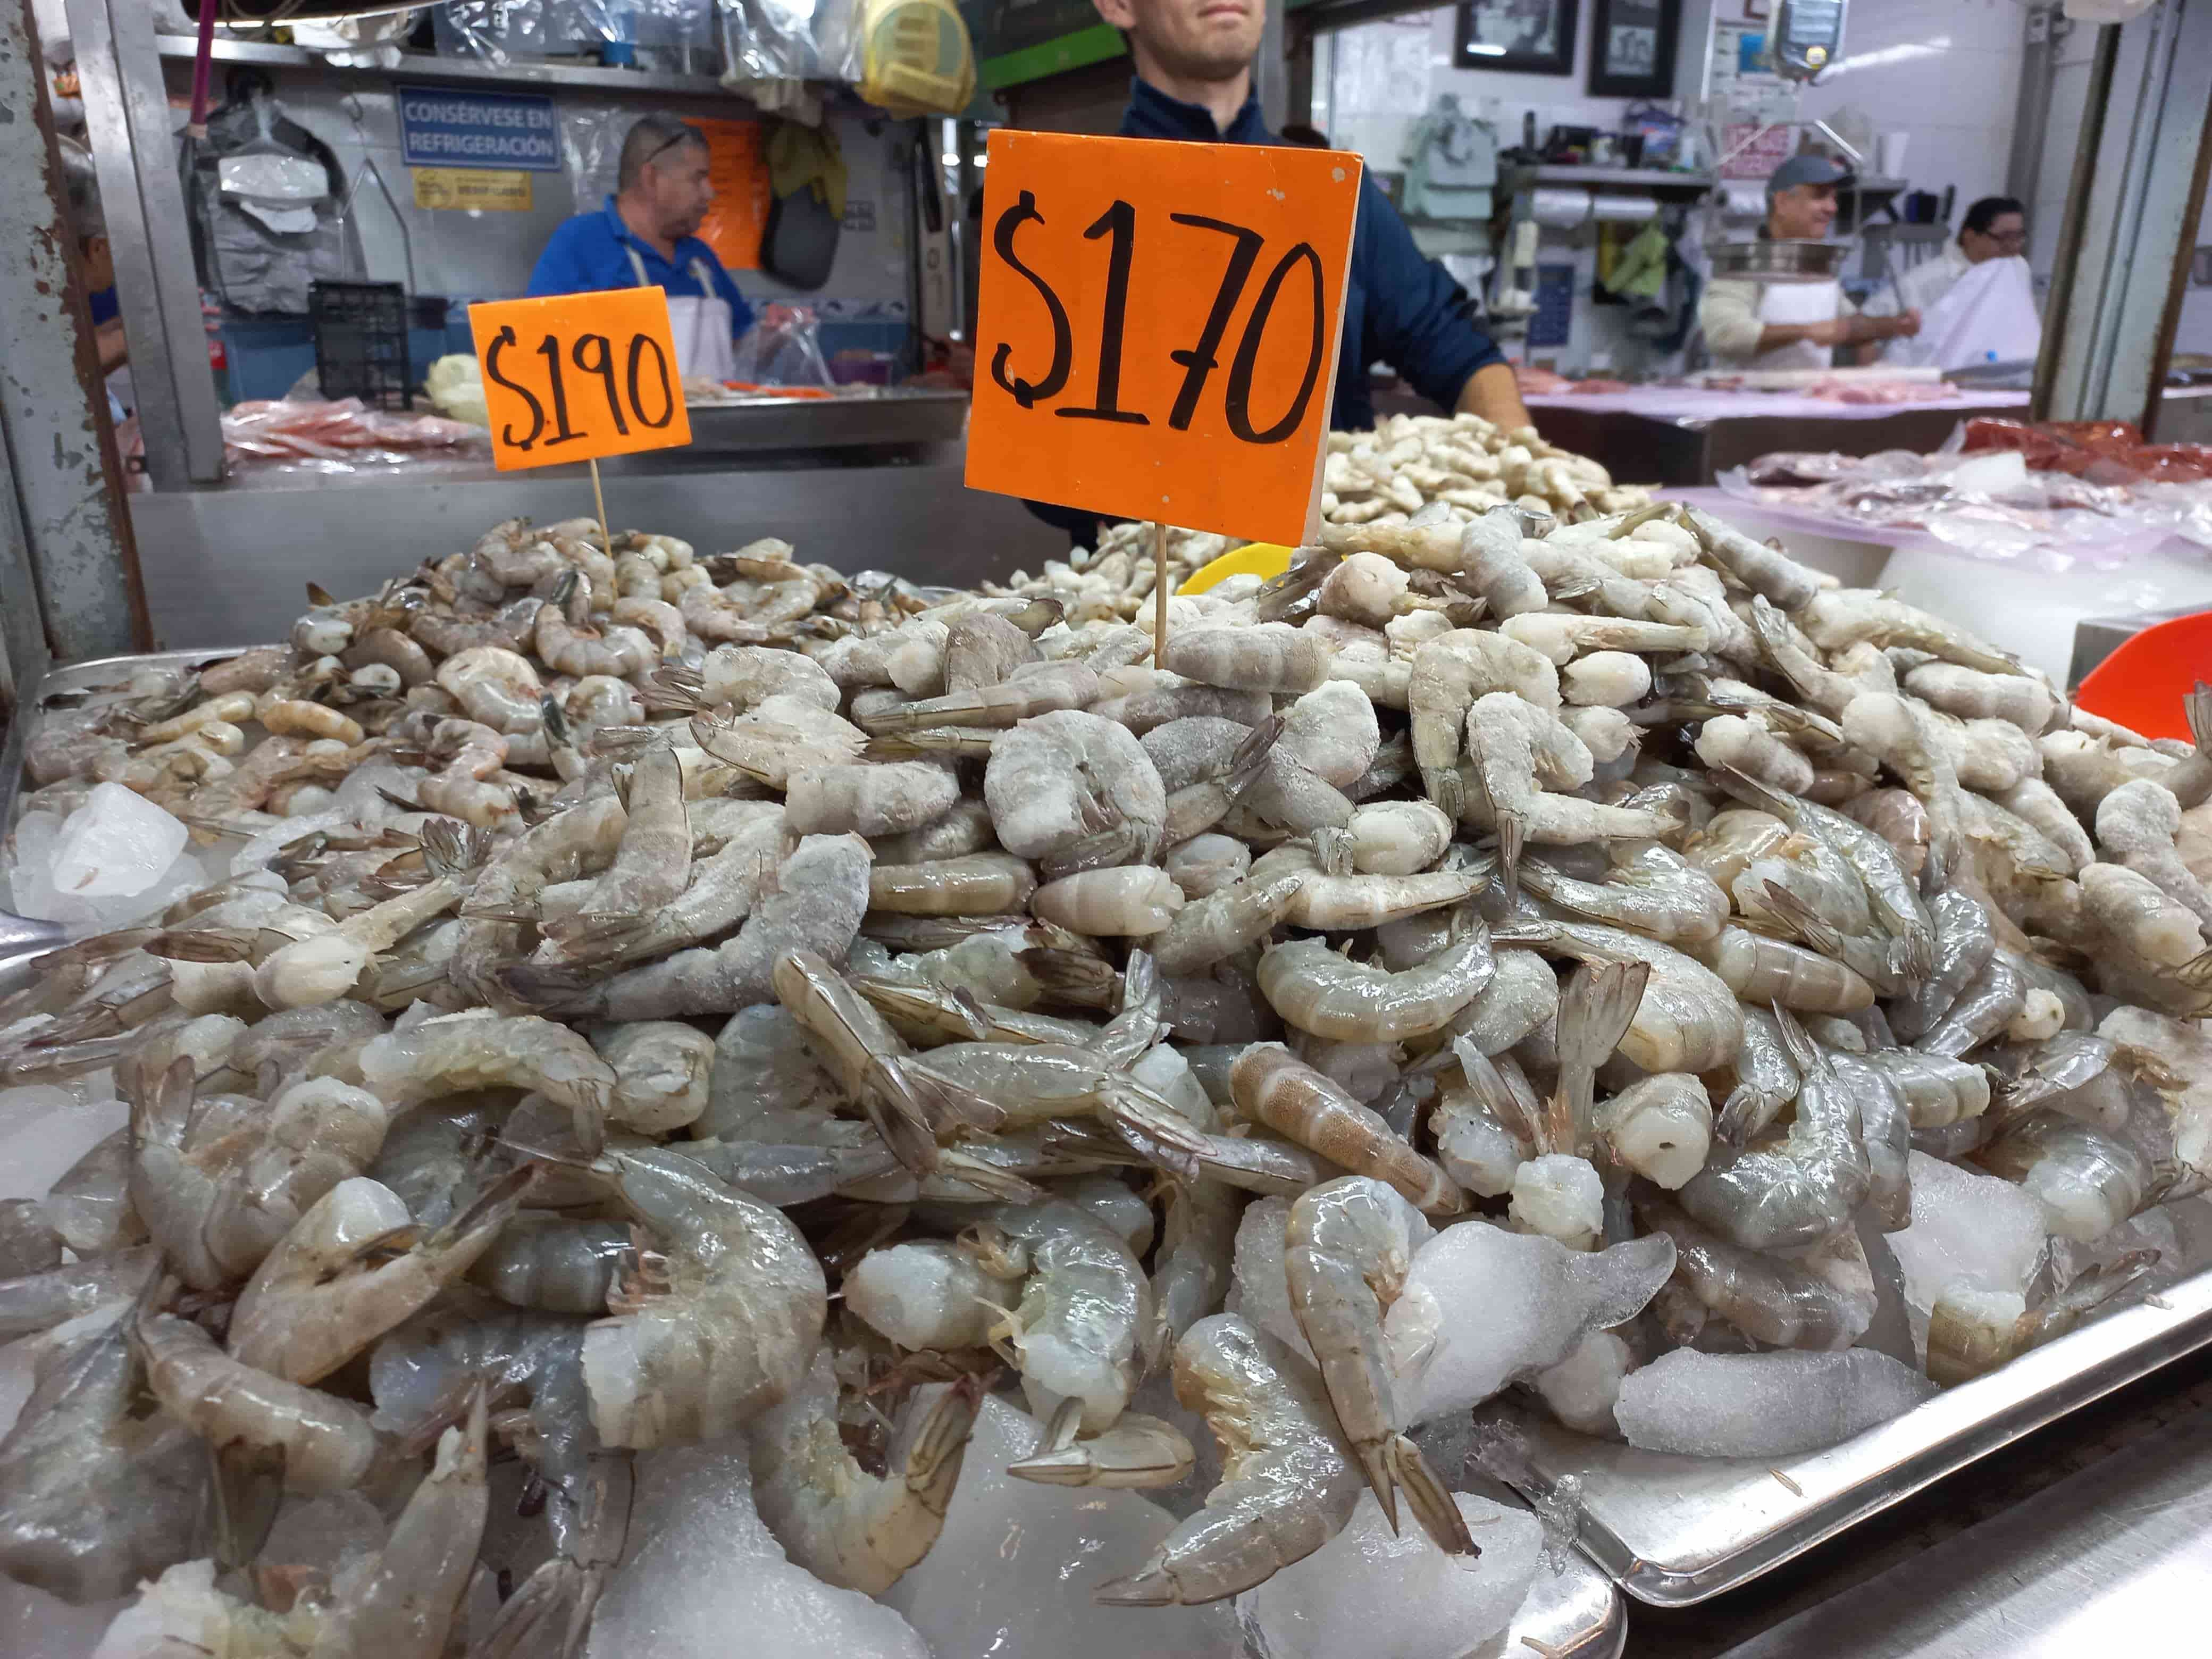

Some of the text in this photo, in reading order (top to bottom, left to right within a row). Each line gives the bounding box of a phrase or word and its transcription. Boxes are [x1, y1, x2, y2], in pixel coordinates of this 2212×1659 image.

[404, 101, 552, 129] CONSÉRVESE EN
[408, 132, 554, 156] REFRIGERACIÓN
[991, 190, 1325, 445] $170
[486, 325, 674, 451] $190
